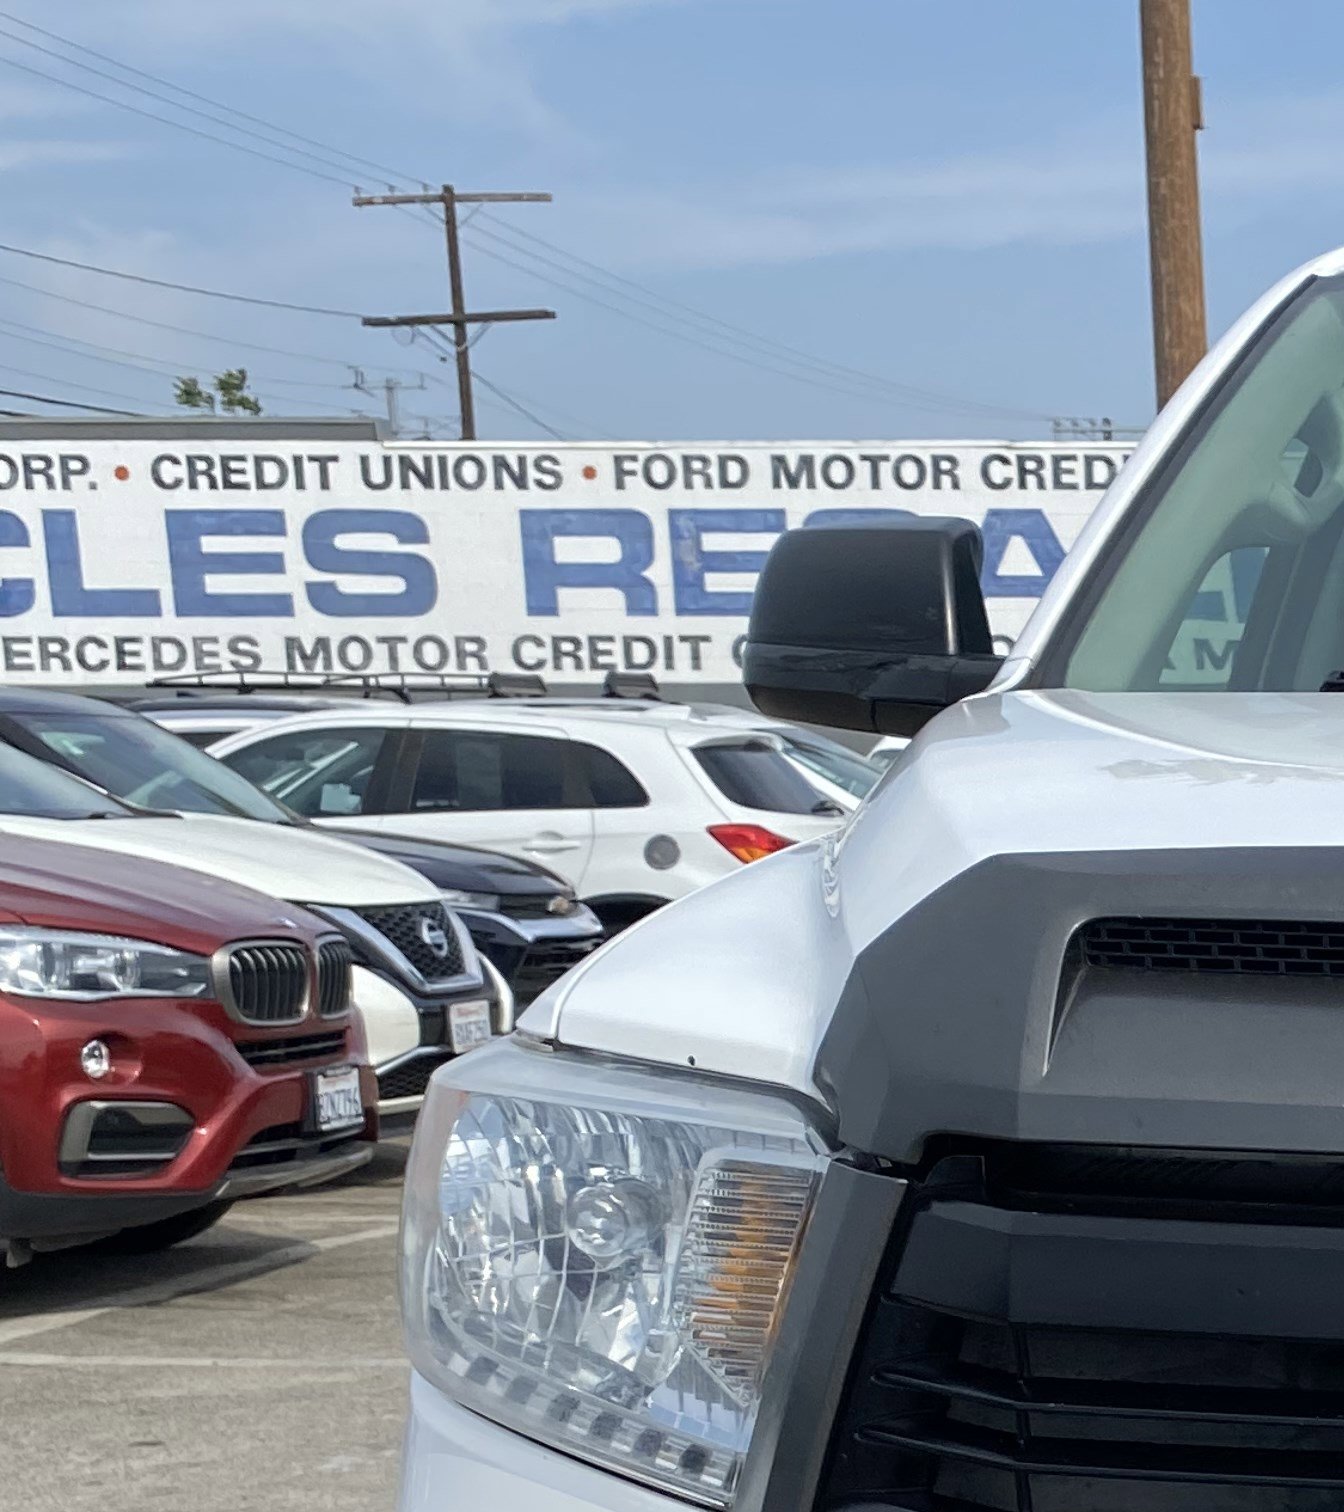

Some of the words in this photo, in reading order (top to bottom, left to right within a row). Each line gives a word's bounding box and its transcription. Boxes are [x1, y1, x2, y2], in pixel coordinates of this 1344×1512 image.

[151, 453, 340, 491] CREDIT
[360, 453, 564, 491] UNIONS
[614, 453, 750, 490] FORD
[771, 453, 962, 490] MOTOR
[980, 453, 1132, 490] CRED
[2, 635, 262, 672] ERCEDES
[285, 635, 488, 672] MOTOR
[512, 635, 712, 671] CREDIT
